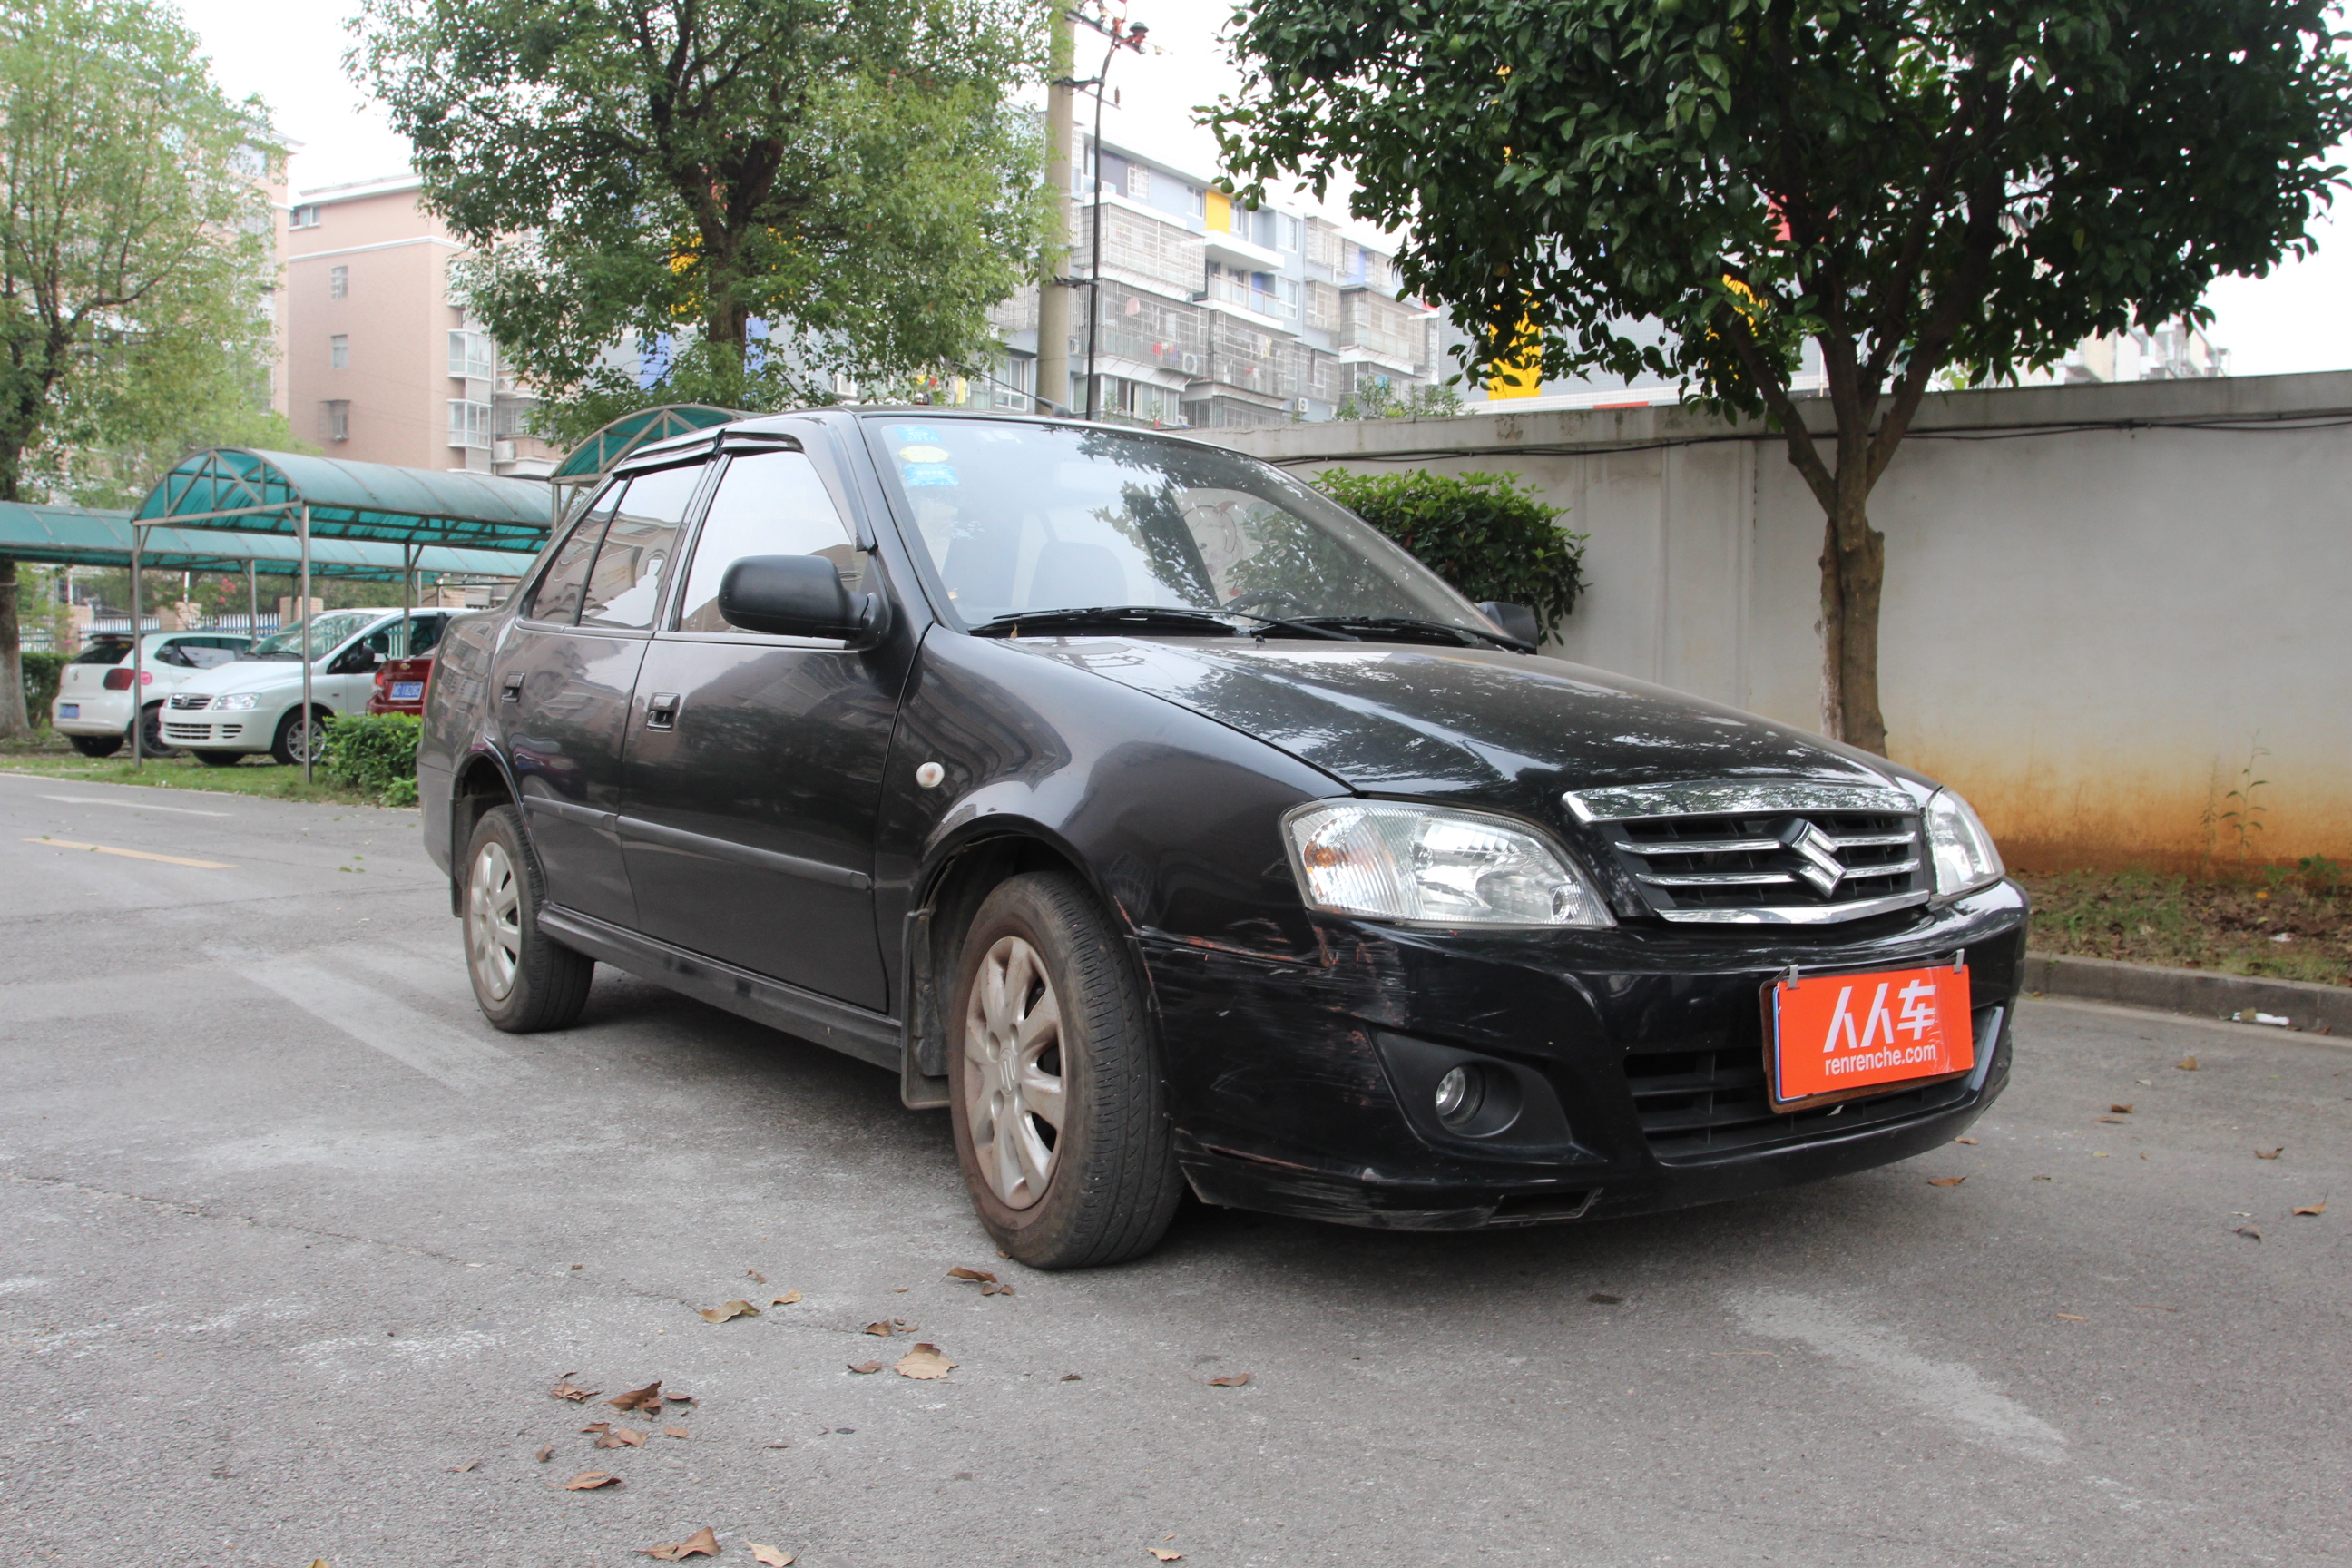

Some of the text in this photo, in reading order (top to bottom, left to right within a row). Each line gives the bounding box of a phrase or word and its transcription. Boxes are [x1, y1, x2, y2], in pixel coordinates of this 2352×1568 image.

[1823, 979, 1936, 1053] 人人车
[1825, 1044, 1936, 1076] renrenche.com
